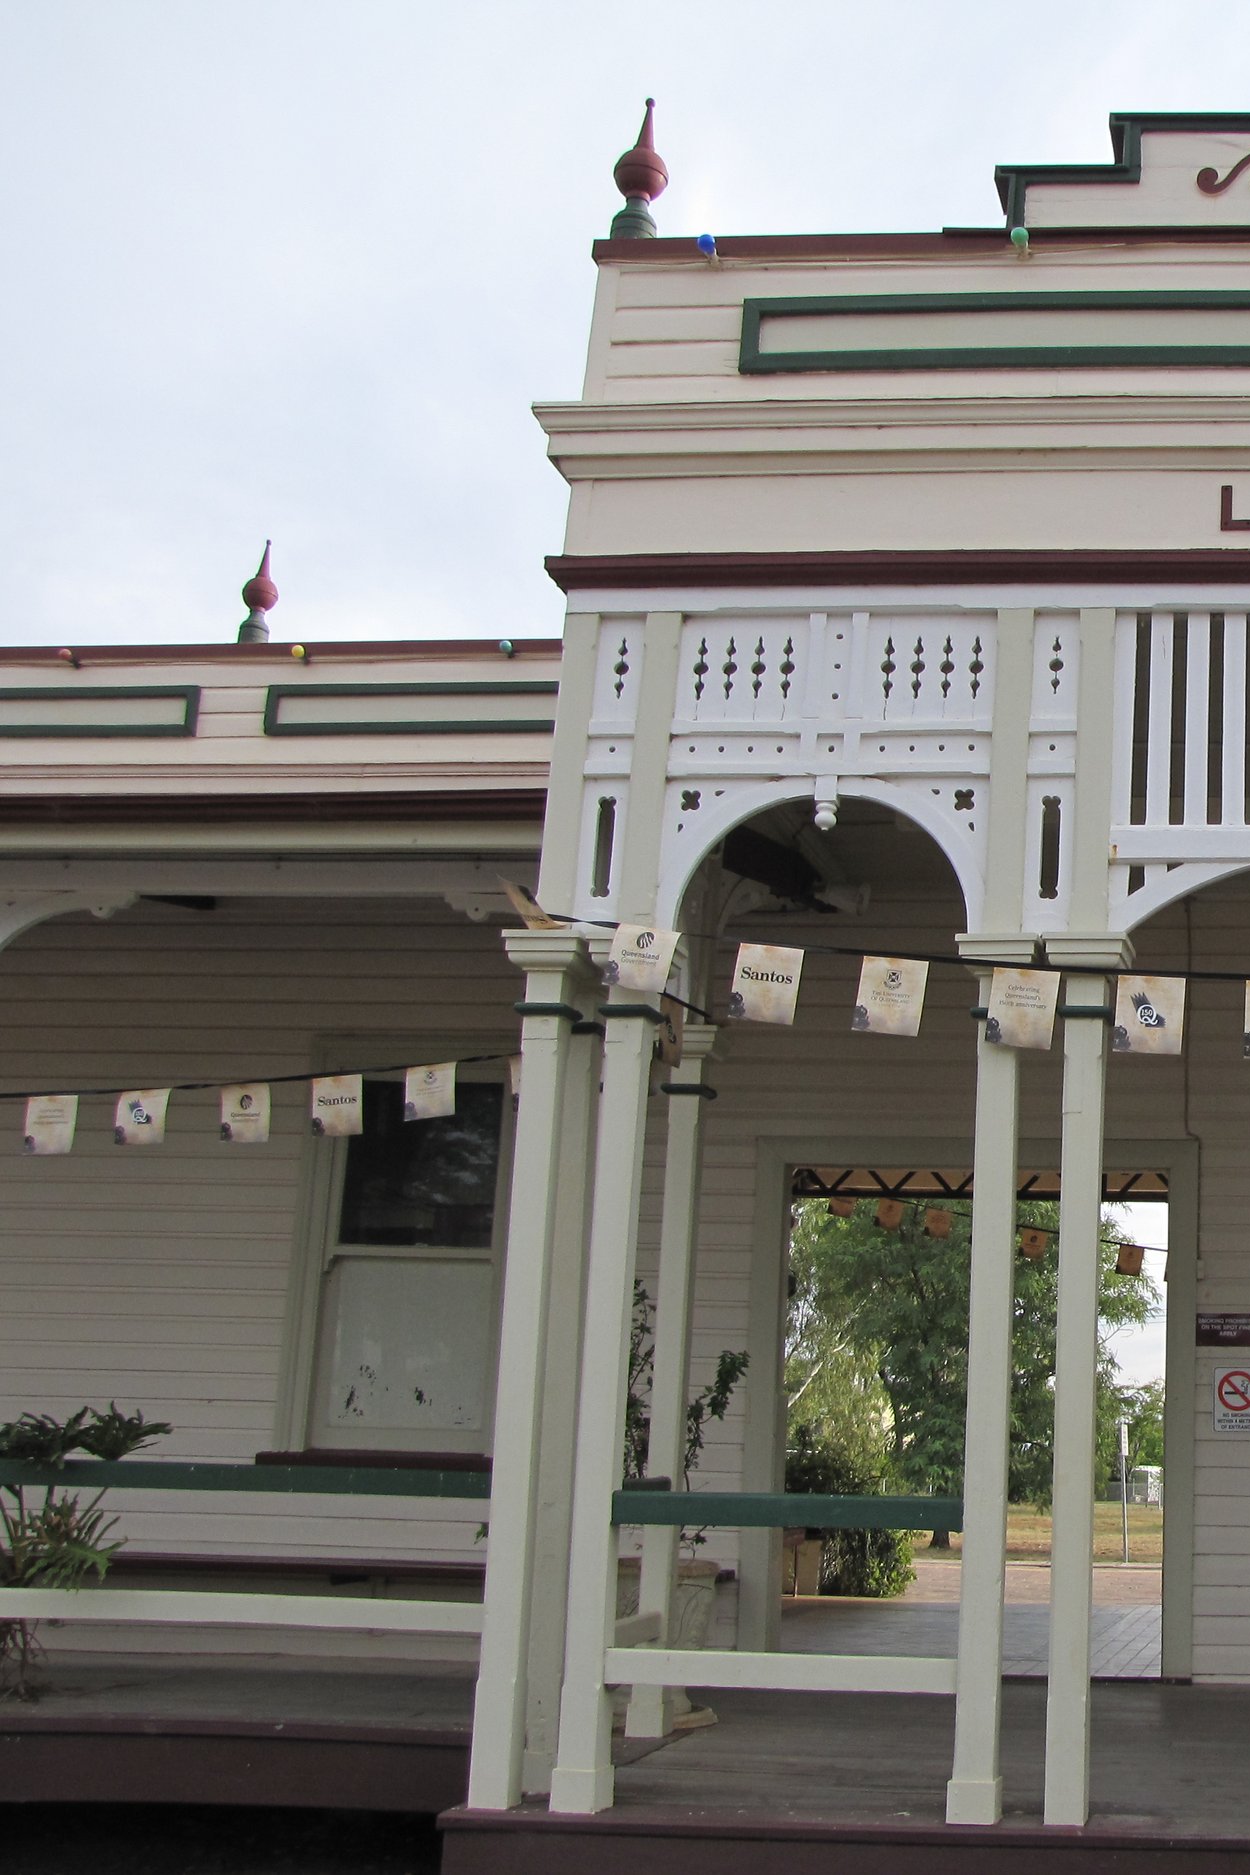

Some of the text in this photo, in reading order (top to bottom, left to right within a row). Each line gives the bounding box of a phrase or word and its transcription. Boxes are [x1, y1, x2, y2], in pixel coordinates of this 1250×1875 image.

[621, 950, 660, 960] Queensland
[740, 966, 793, 985] Santos
[317, 1095, 357, 1107] Santos
